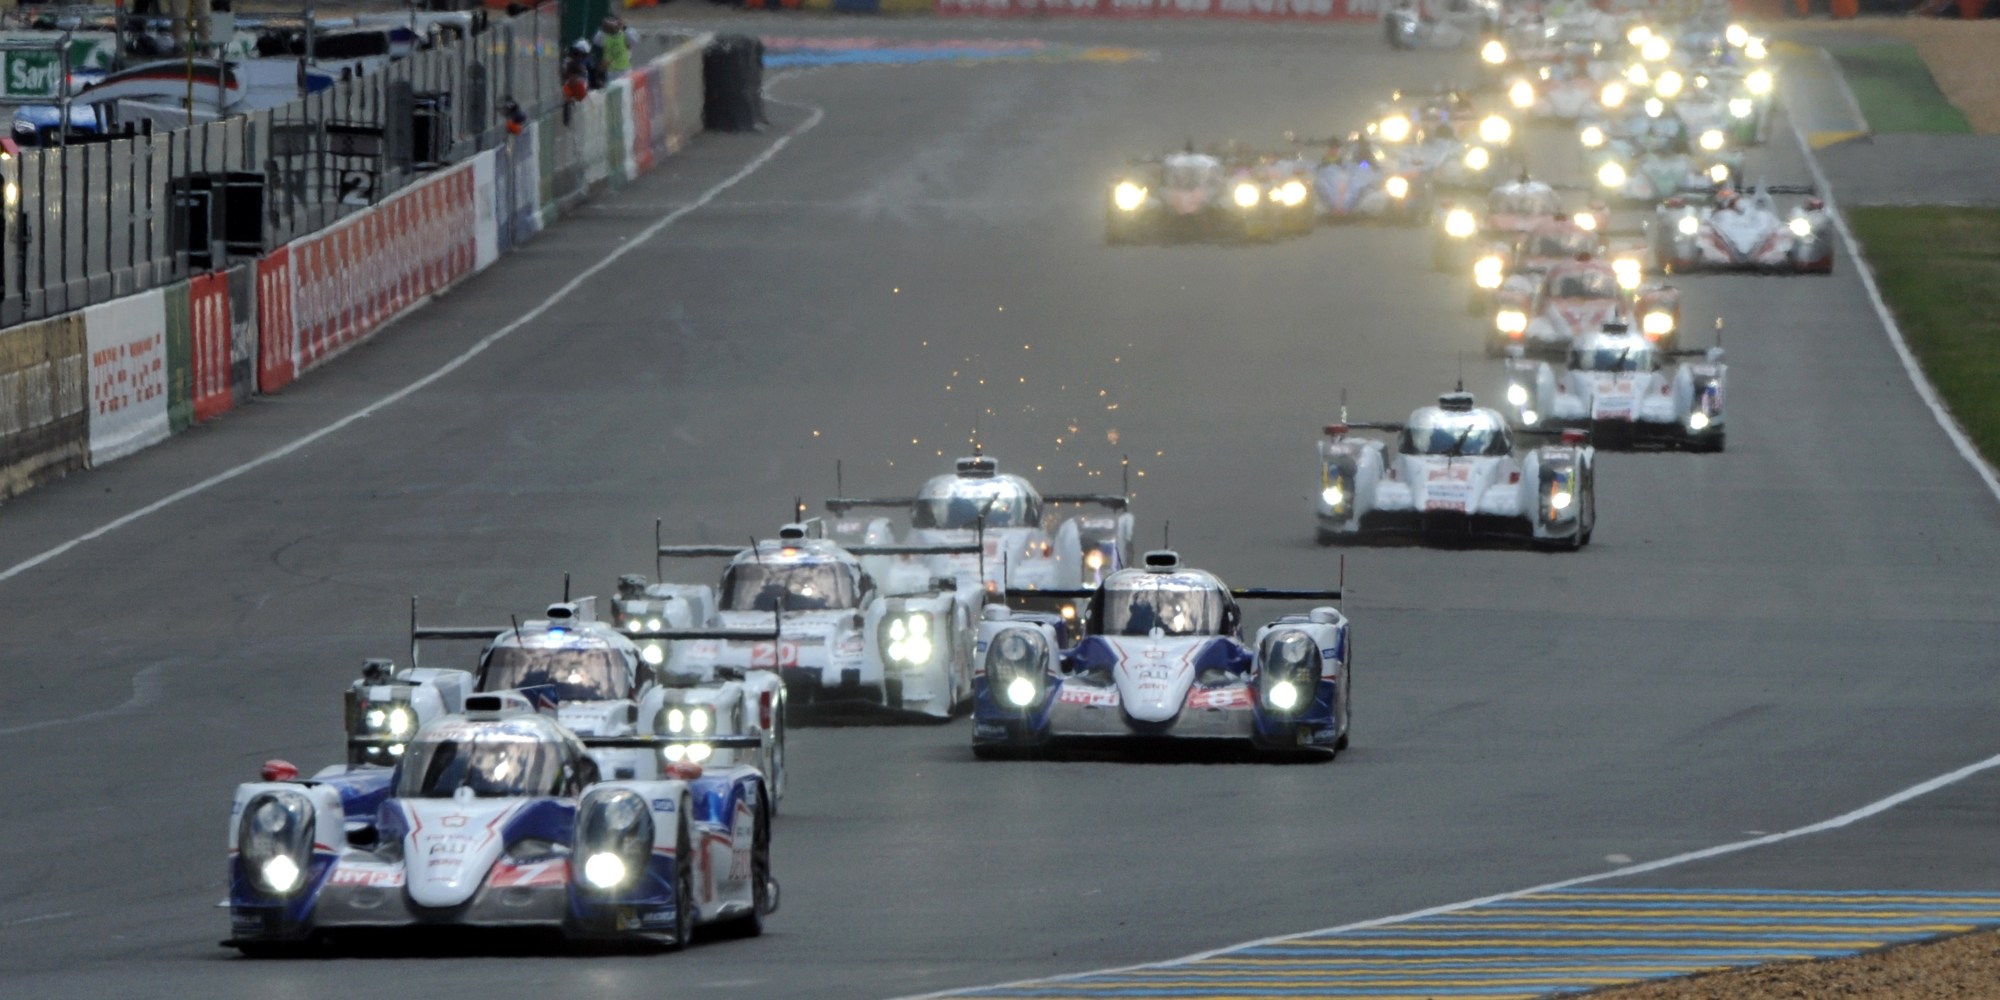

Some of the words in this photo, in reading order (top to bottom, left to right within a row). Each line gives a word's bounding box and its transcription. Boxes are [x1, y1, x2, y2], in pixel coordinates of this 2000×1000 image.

[343, 171, 371, 206] 2
[752, 641, 797, 666] 20
[1207, 689, 1233, 707] 8
[513, 862, 550, 886] 7
